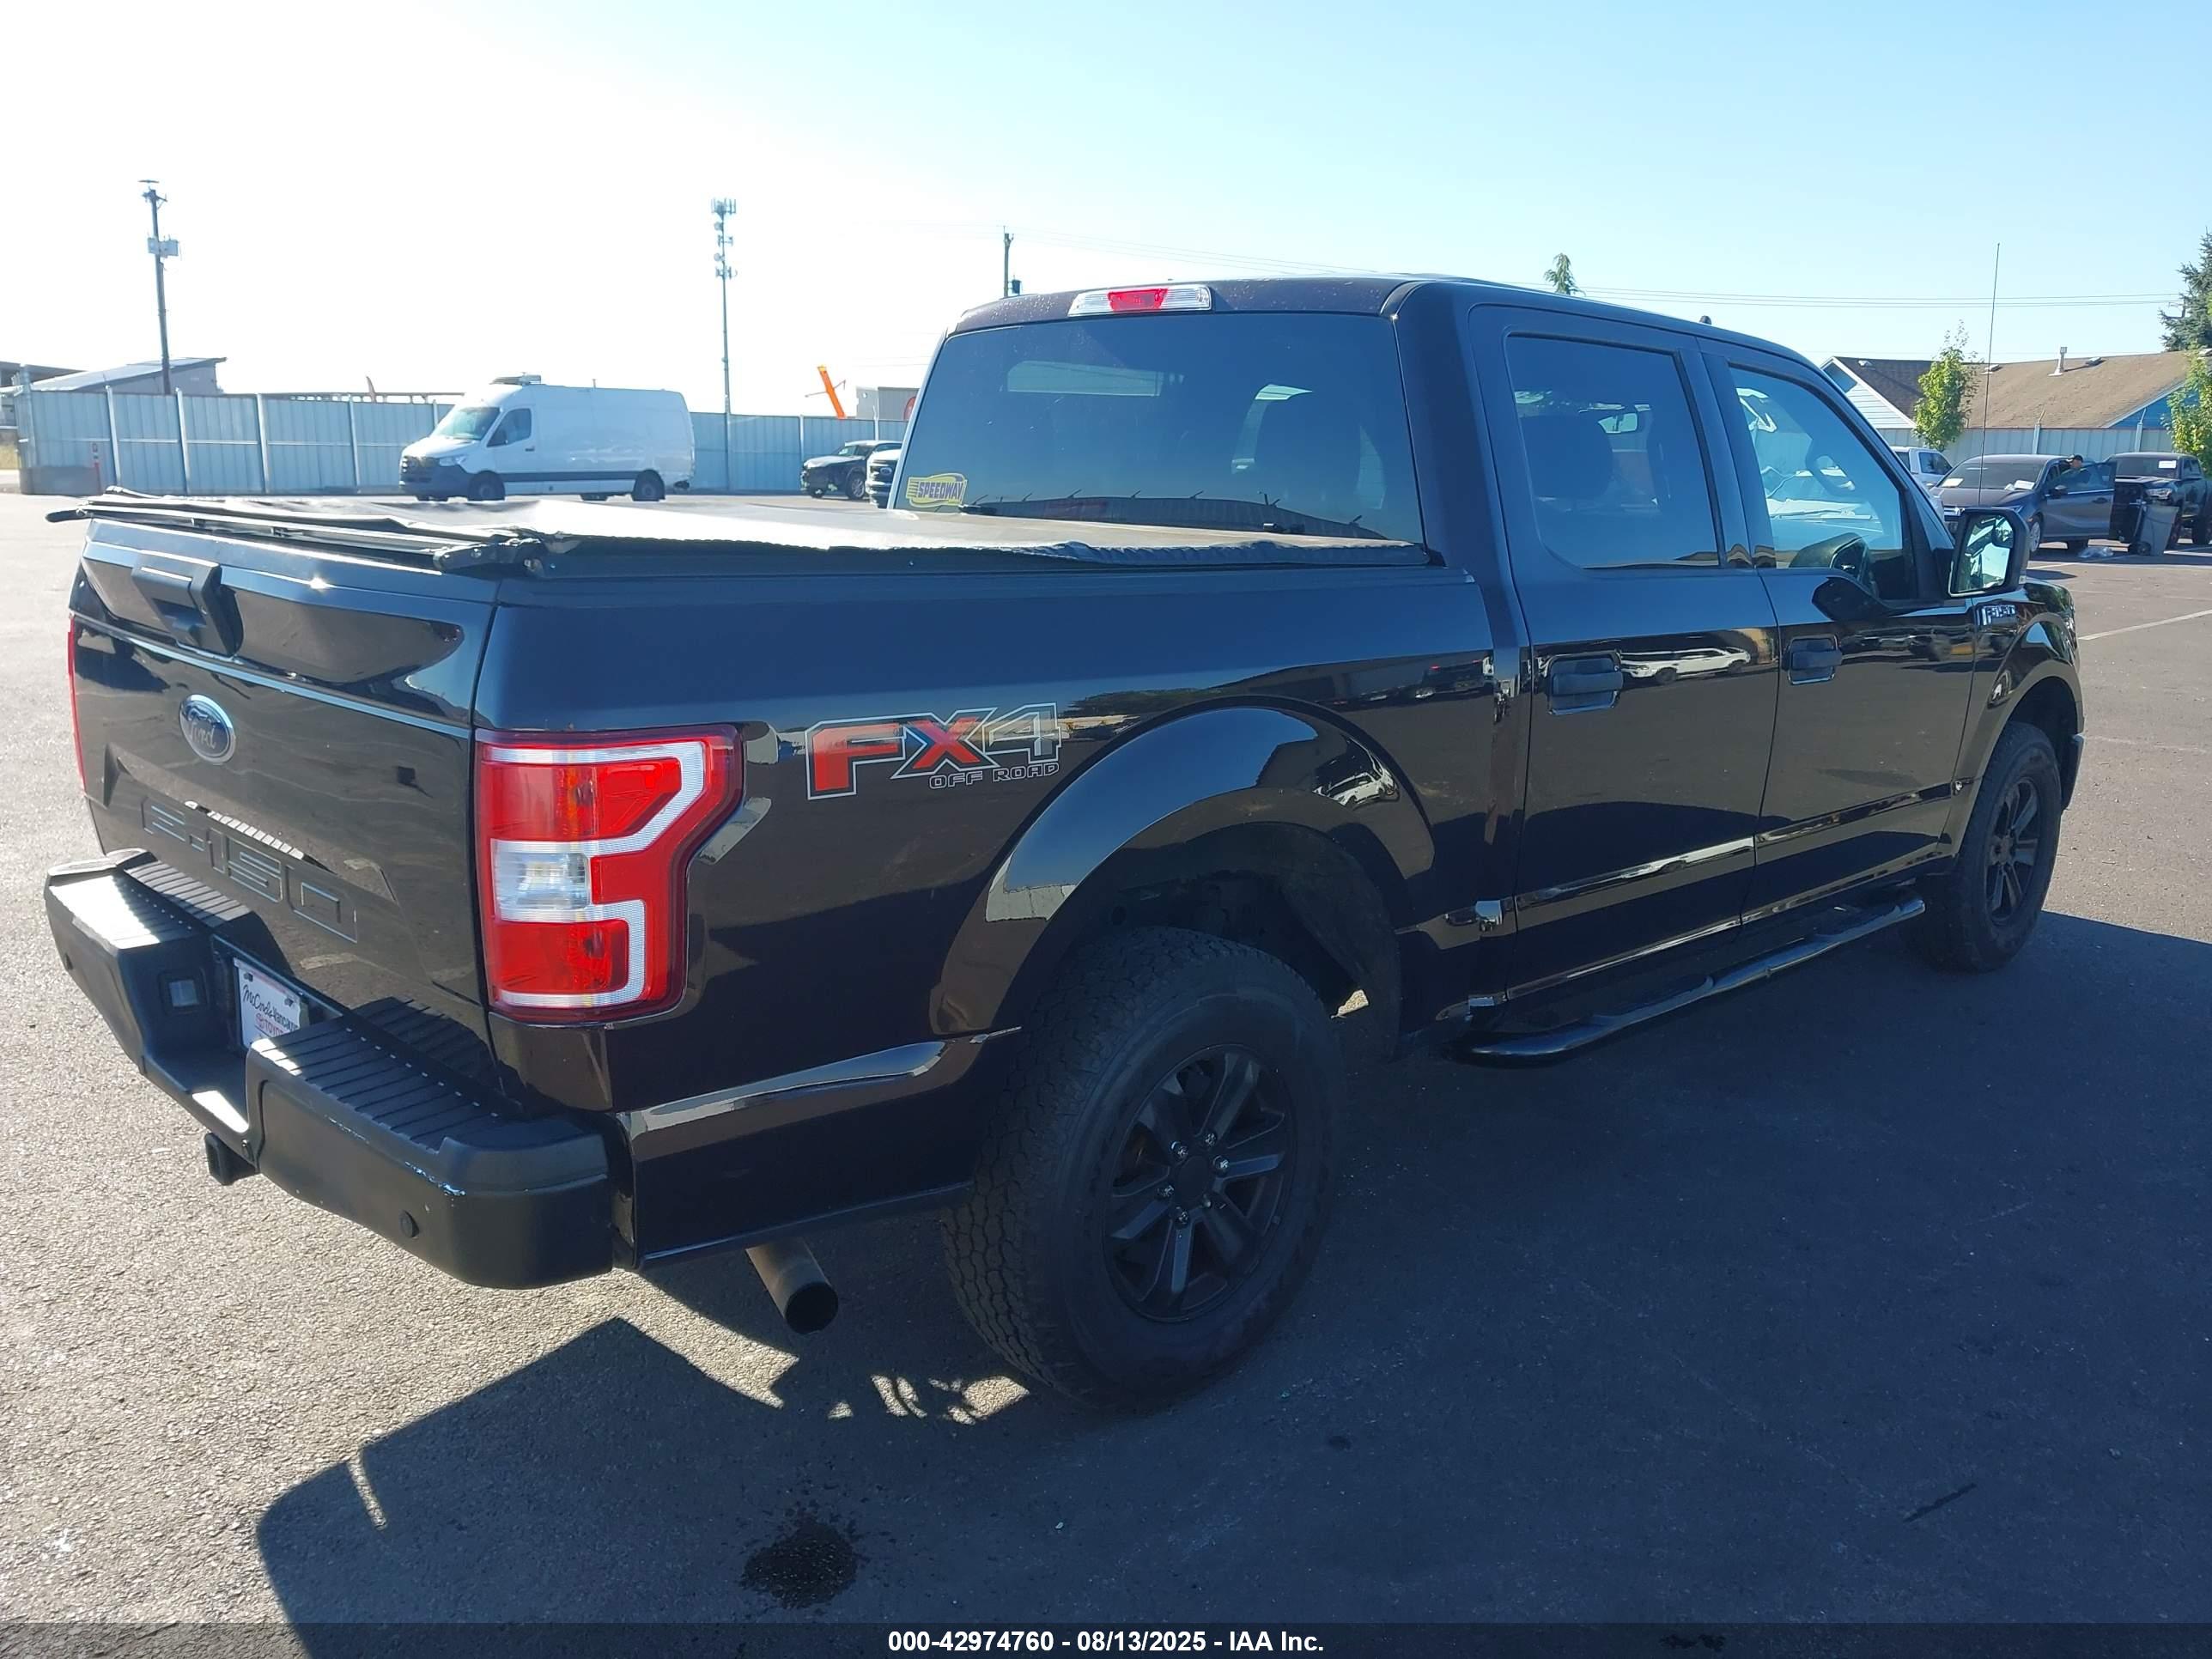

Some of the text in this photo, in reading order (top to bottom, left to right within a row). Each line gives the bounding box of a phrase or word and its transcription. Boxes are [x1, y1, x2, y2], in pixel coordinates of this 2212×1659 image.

[916, 481, 963, 501] SPEEDWAY
[805, 702, 1061, 800] FX4
[929, 762, 1060, 789] OFF ROAD
[141, 796, 358, 943] F-150
